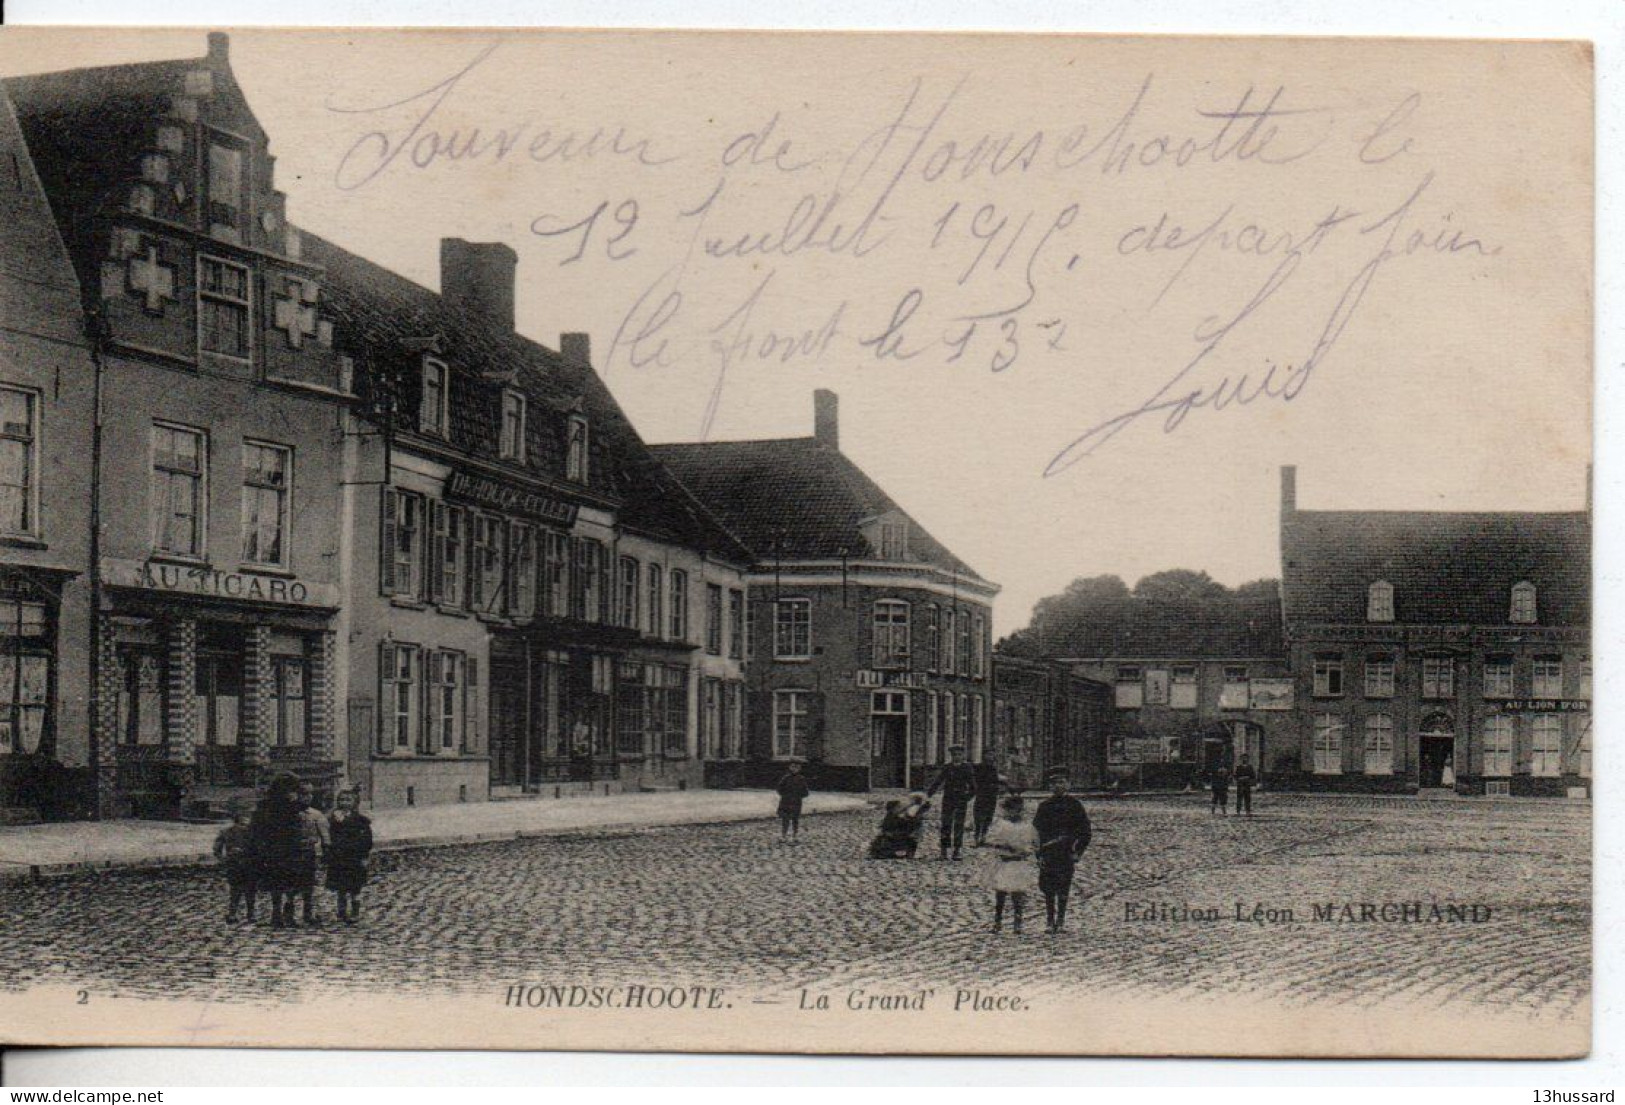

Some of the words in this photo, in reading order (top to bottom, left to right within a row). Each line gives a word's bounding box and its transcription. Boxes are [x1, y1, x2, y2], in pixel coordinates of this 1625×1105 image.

[722, 111, 828, 172] de
[530, 199, 640, 266] 12
[1043, 250, 1318, 478] Louis
[137, 558, 180, 588] AU
[1505, 701, 1522, 710] AU
[1528, 701, 1556, 710] LION
